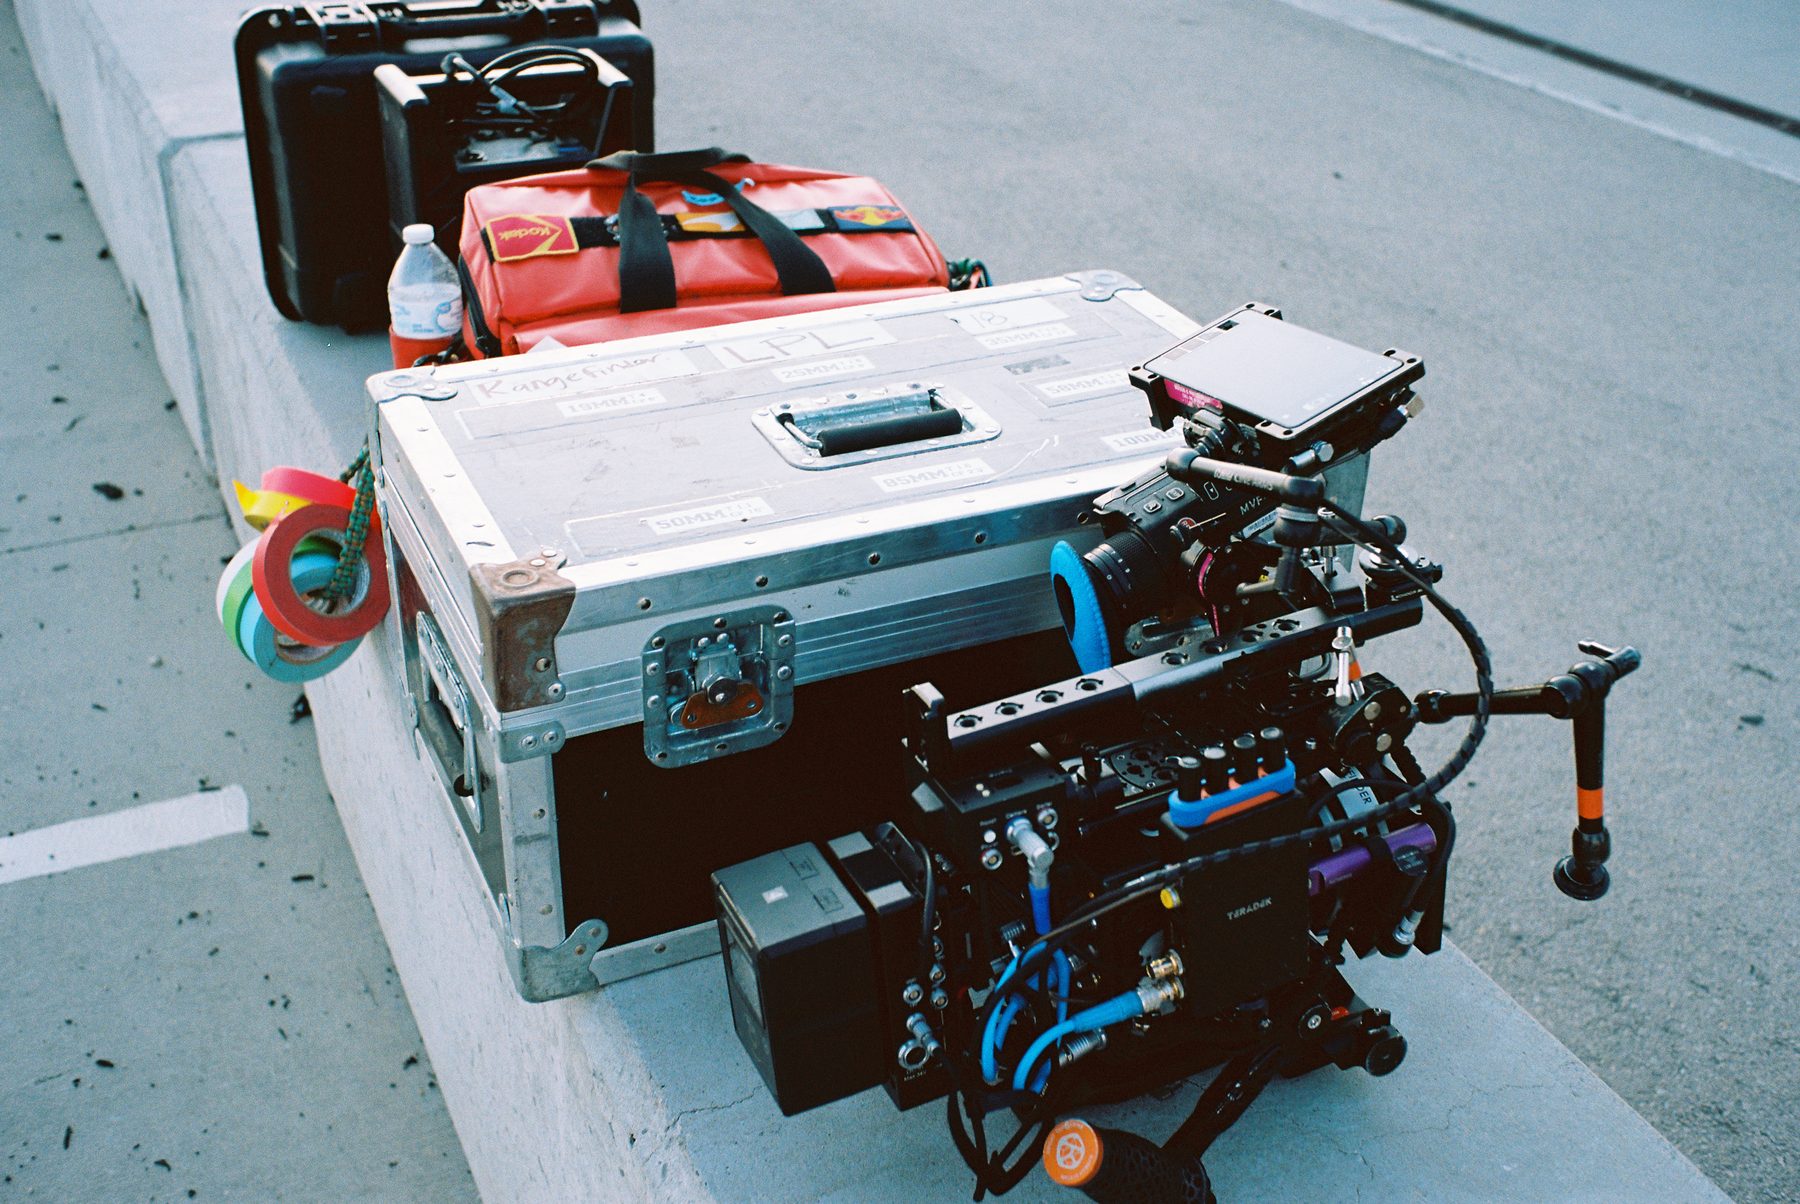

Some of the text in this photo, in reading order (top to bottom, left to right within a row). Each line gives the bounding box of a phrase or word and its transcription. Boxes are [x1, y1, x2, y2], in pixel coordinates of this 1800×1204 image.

[722, 330, 875, 363] LPL
[882, 469, 948, 488] 85MM
[655, 509, 729, 530] 50MM
[1226, 896, 1273, 921] TERADEK
